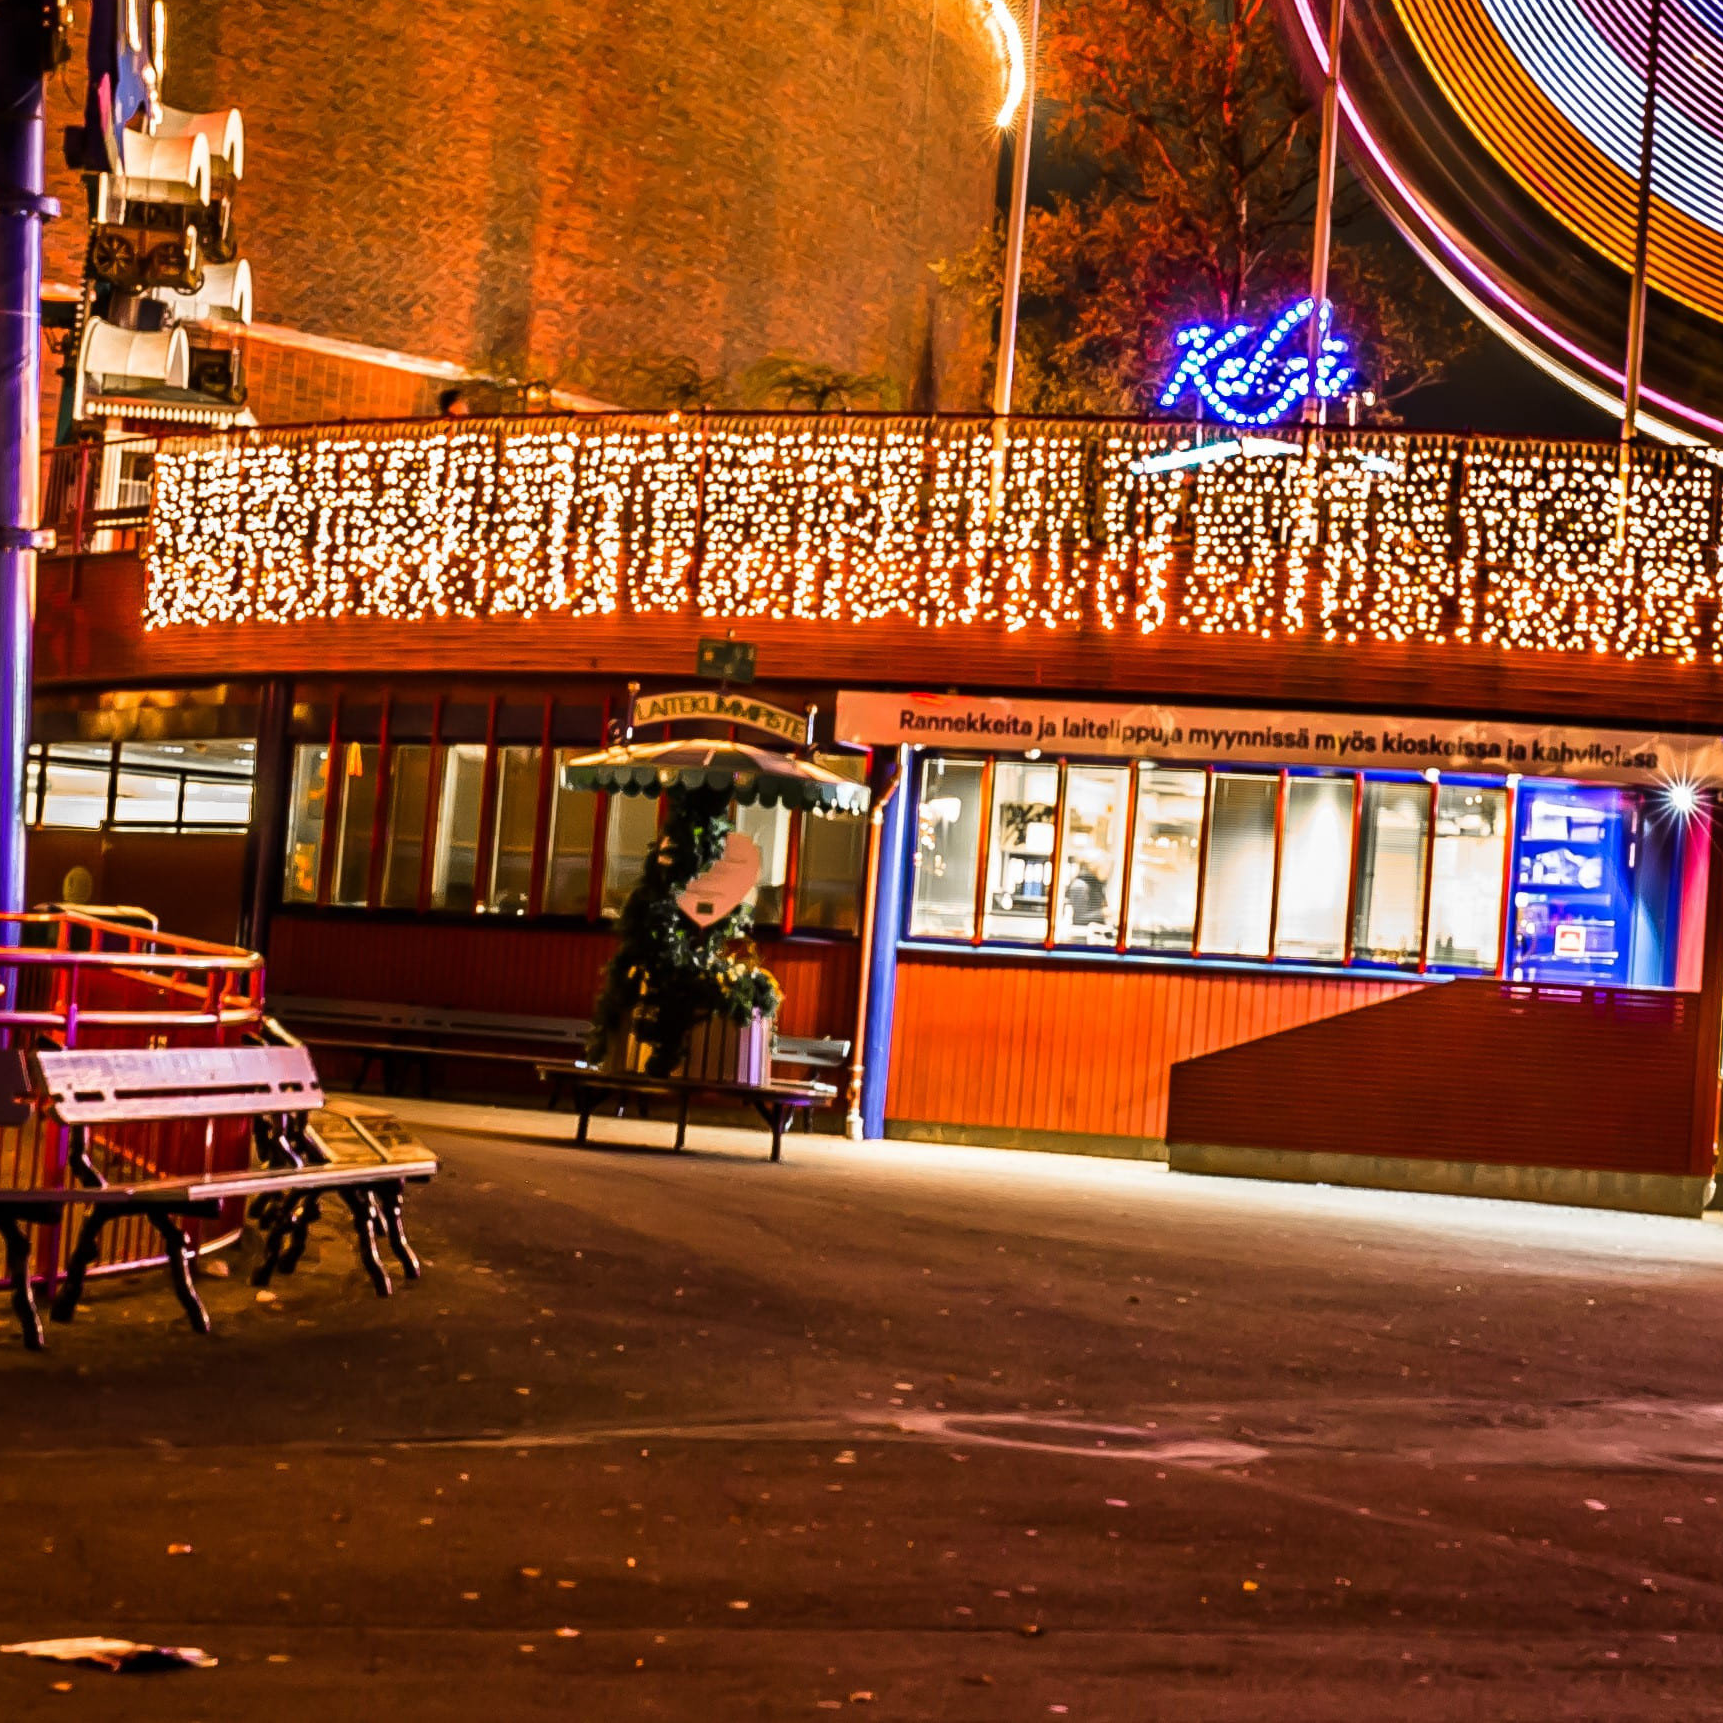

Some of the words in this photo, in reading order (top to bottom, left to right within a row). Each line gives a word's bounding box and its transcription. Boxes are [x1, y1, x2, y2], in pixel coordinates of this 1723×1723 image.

[899, 710, 1032, 737] Rannekkeita
[1037, 714, 1056, 741] ja
[1063, 716, 1183, 747] laitelippuja
[1188, 726, 1309, 750] myynnissä
[1315, 730, 1376, 756] myös
[1382, 731, 1501, 760] kioskeissa
[1506, 738, 1526, 763] ja
[1531, 739, 1658, 769] kahviloissa
